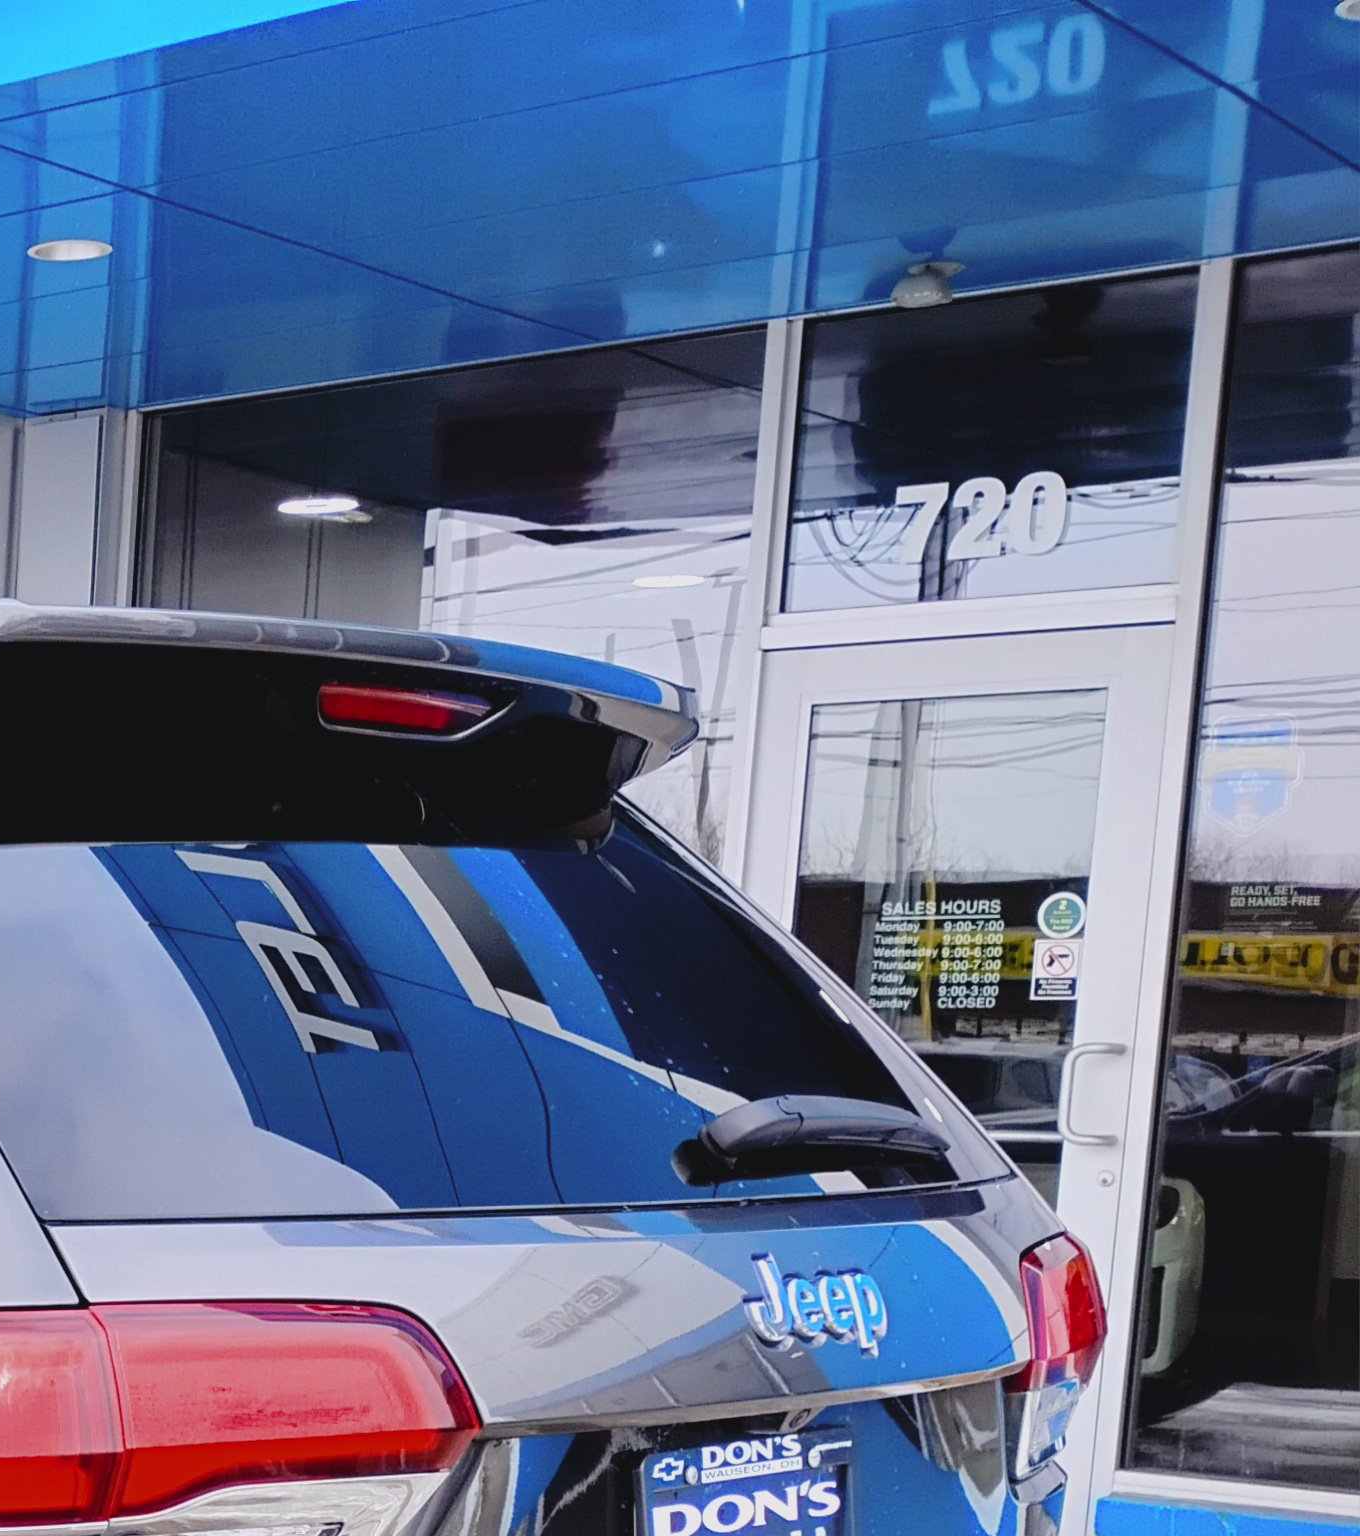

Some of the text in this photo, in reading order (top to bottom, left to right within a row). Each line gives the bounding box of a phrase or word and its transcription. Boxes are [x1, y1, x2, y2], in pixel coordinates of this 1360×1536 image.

[895, 470, 1068, 564] 720
[1231, 885, 1298, 896] READY, SET,
[1231, 895, 1321, 907] GO HANDS-FREE
[881, 899, 1002, 917] SALES HOURS
[875, 920, 1005, 933] Monday 9:00-7:00
[875, 933, 1004, 946] Tuesday 9:00-6:00
[873, 946, 1003, 959] Wednesday 9:00-6:00
[872, 959, 1002, 972] Thursday 9:00-7:00
[870, 972, 1000, 985] Friday 9:00-6:00
[869, 985, 999, 997] Saturday 9:00-3:00
[868, 997, 996, 1011] Sunday CLOSED
[743, 1251, 888, 1359] Jeep
[701, 1434, 802, 1469] DON'S
[780, 1459, 801, 1470] OH
